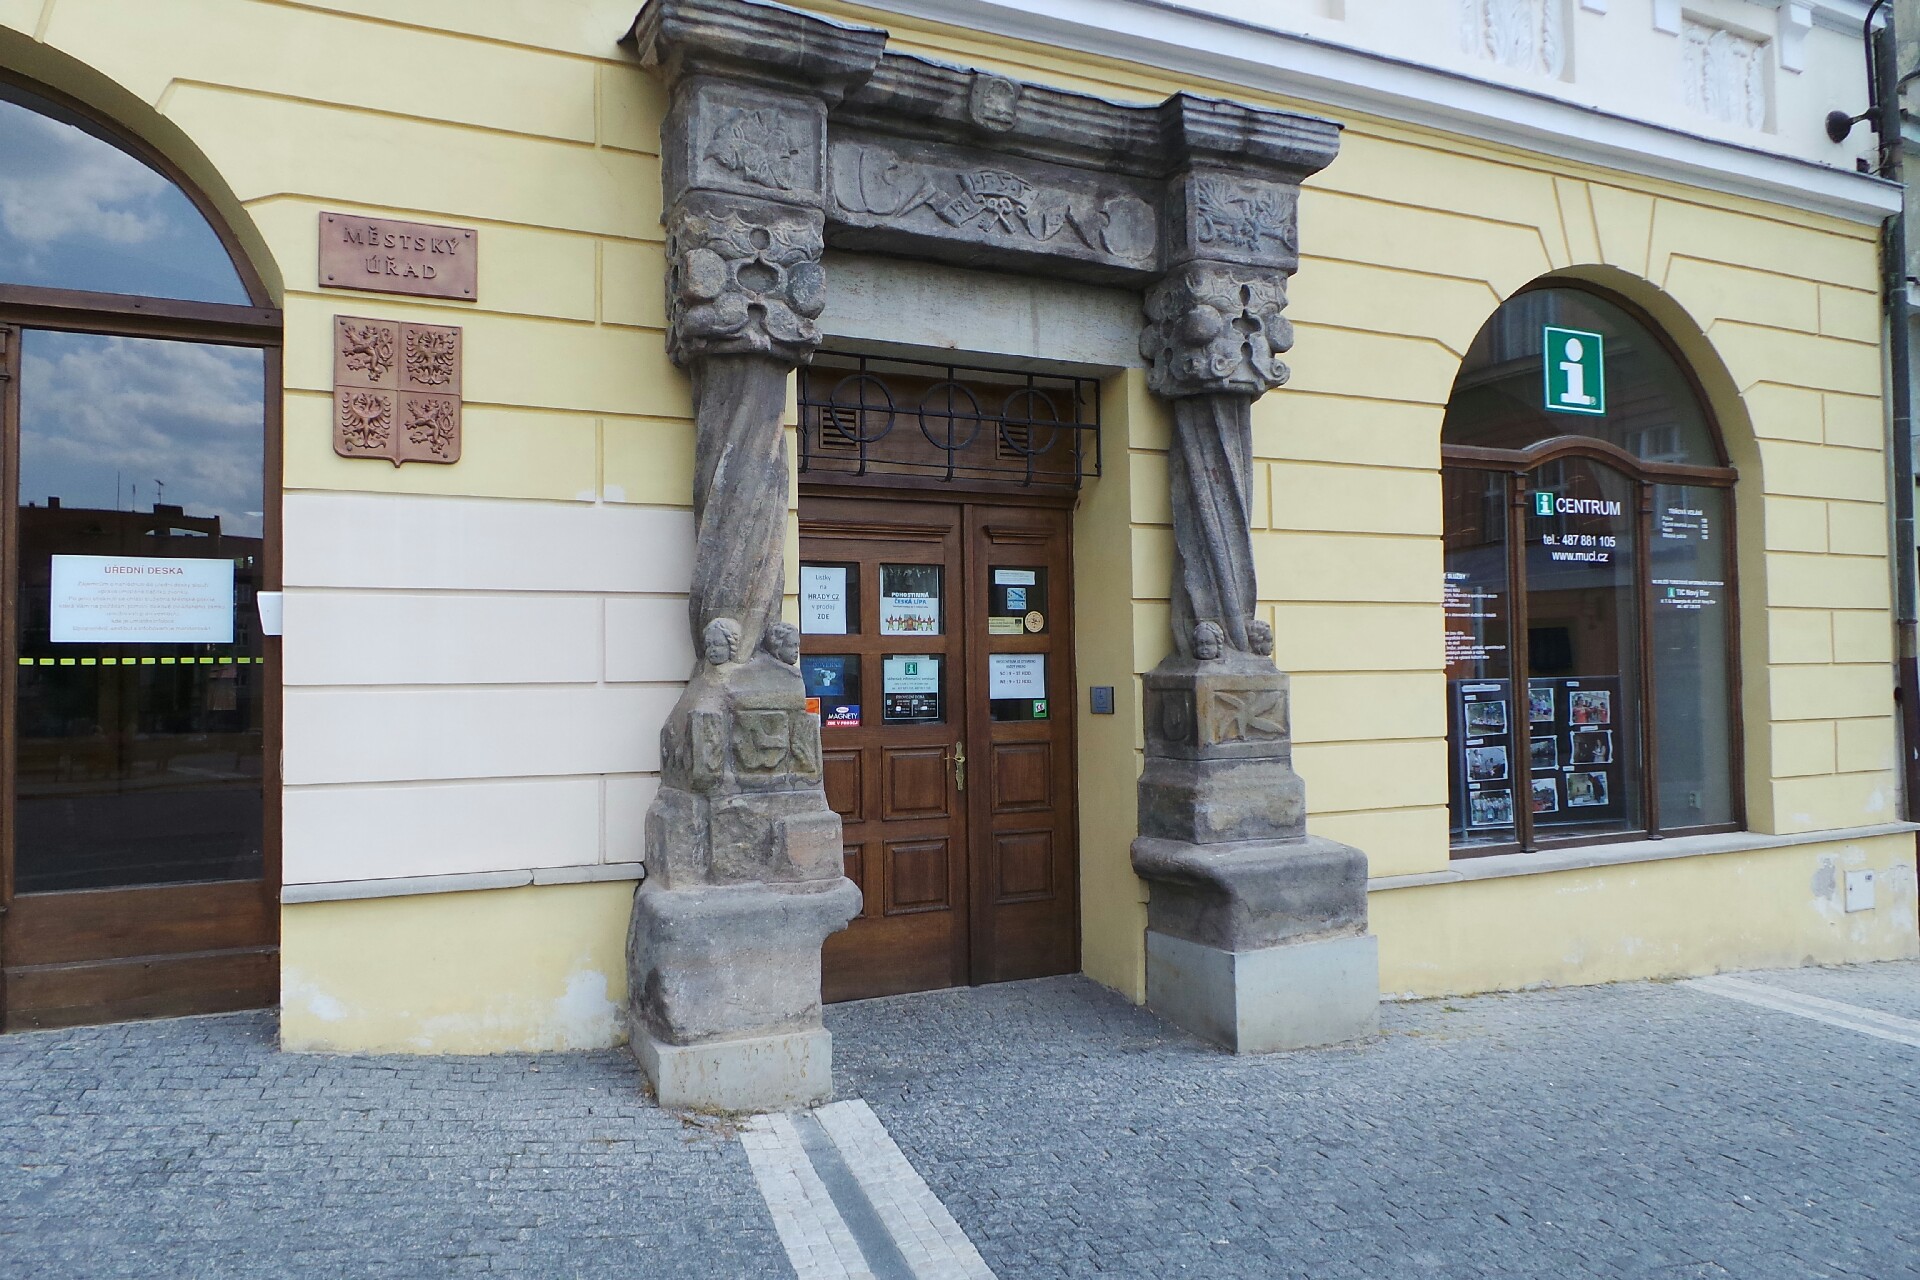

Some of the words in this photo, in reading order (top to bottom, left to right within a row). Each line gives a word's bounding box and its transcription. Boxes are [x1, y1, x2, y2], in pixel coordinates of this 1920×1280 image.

[343, 226, 459, 255] MĚSTSKÝ
[366, 255, 438, 279] ÚŘAD
[1556, 498, 1621, 516] CENTRUM
[1543, 533, 1560, 545] tel.:
[1562, 534, 1579, 546] 487
[1580, 535, 1597, 546] 881
[1600, 536, 1616, 547] 105
[104, 564, 144, 574] ÚŘEDNÍ
[148, 567, 184, 575] DESKA
